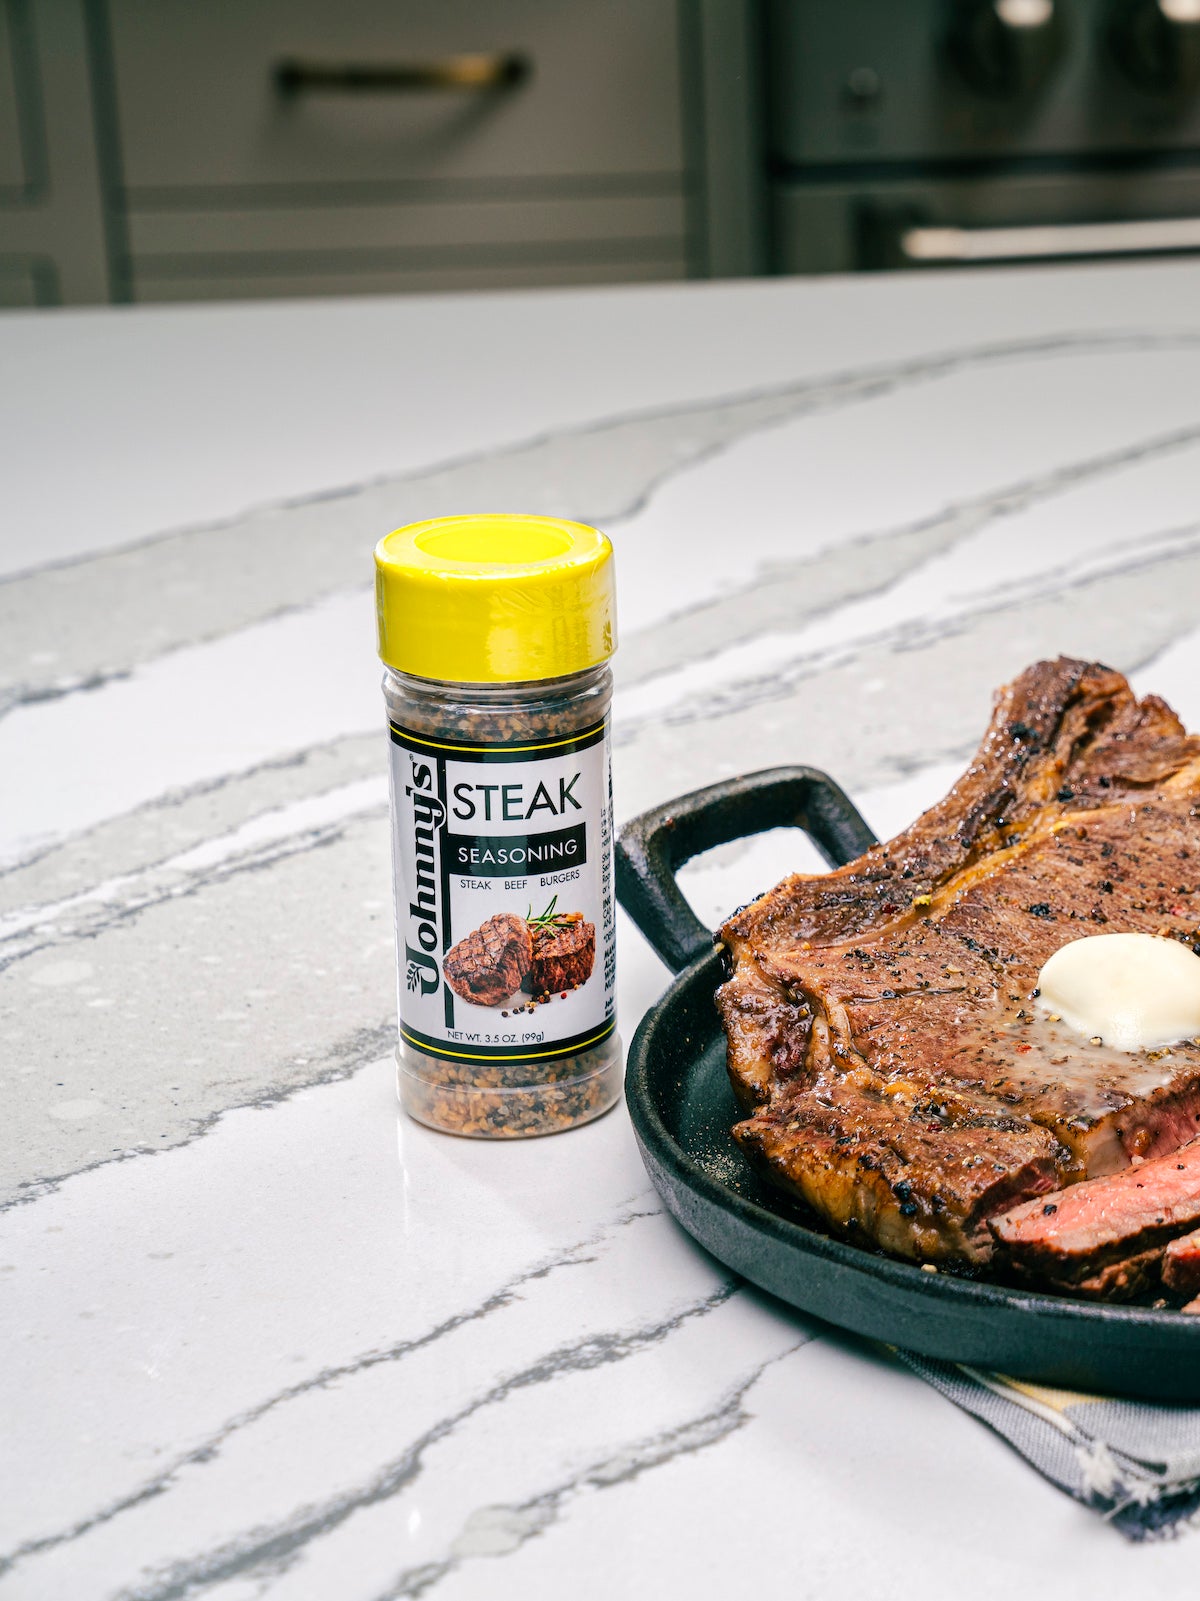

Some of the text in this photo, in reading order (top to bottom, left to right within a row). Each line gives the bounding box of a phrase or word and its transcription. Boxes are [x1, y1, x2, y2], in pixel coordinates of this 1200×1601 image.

[452, 772, 583, 821] STEAK
[458, 839, 578, 864] SEASONING
[405, 761, 446, 997] Johnny's
[460, 869, 580, 890] STEAK BEEF BURGERS
[447, 1030, 545, 1043] NET WT. 3.5 OZ. (99g)
